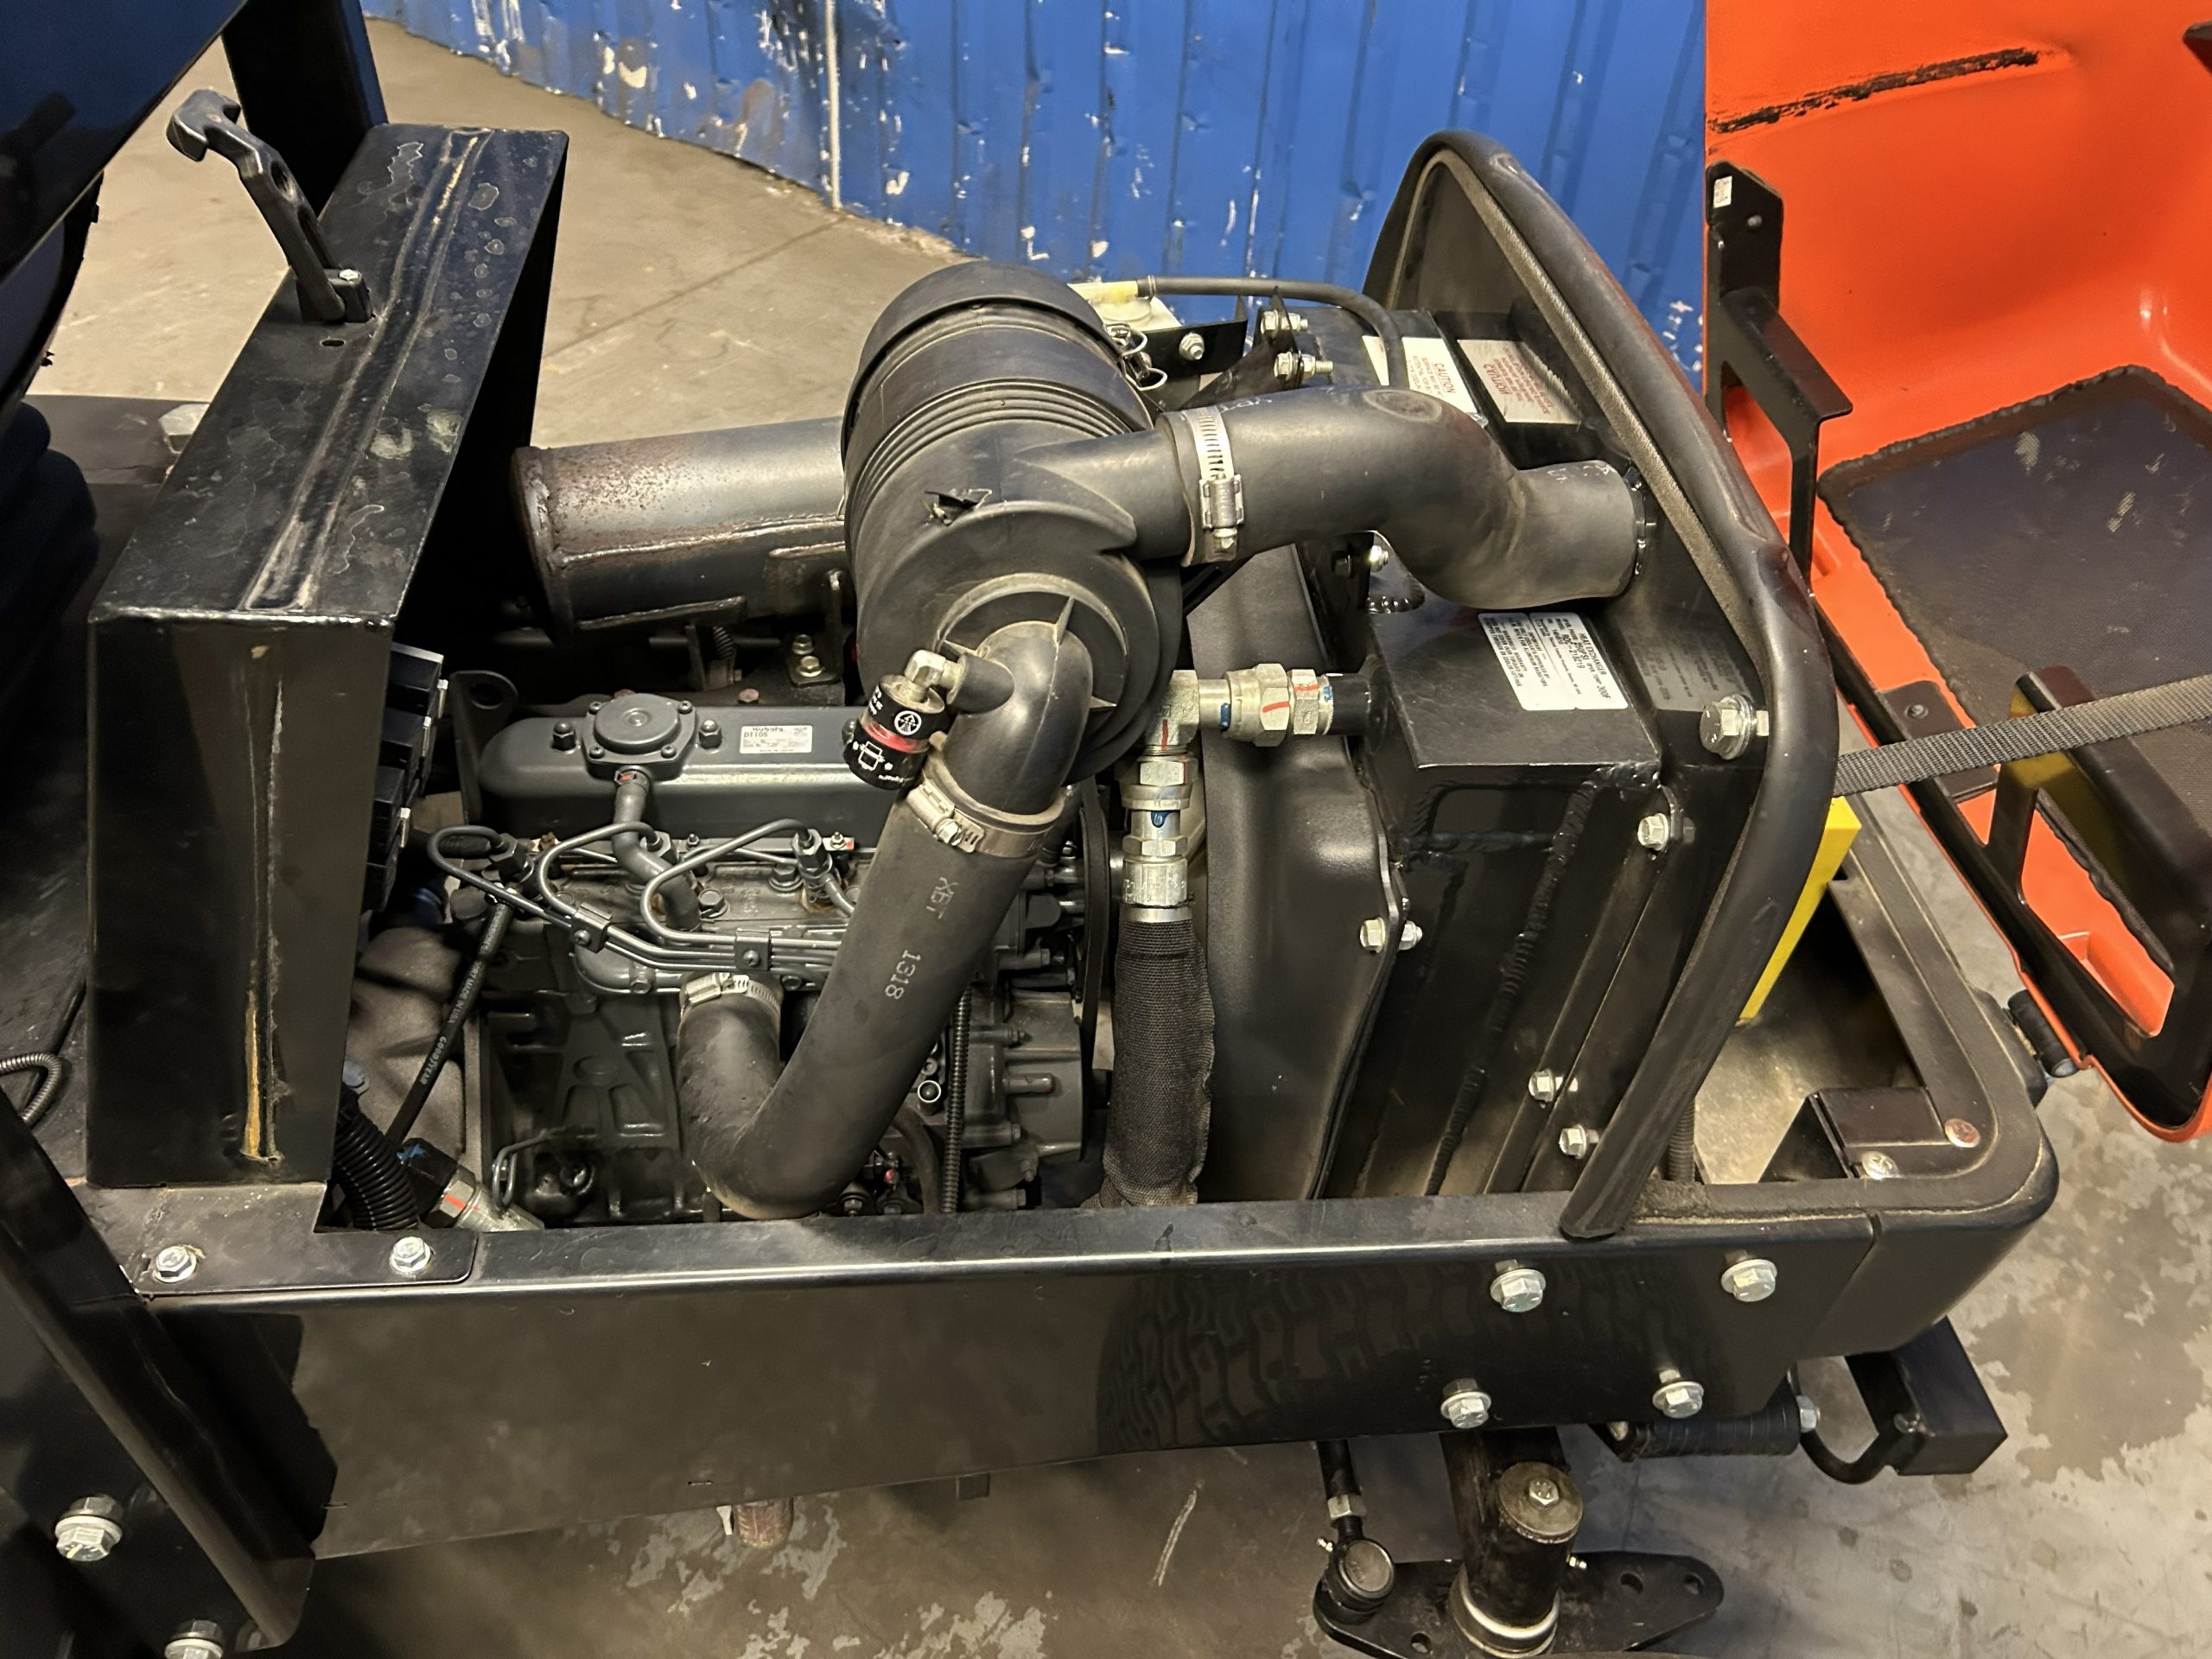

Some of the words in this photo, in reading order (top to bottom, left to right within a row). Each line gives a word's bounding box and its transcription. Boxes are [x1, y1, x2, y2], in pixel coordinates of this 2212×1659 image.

[1433, 363, 1456, 393] CAUTION
[1577, 632, 1591, 645] HEAT
[1585, 645, 1607, 675] EXCHANGER
[1595, 685, 1611, 699] 300F
[885, 950, 921, 1000] 1318
[448, 1007, 460, 1024] USA
[420, 1035, 448, 1085] GOODYEAR
